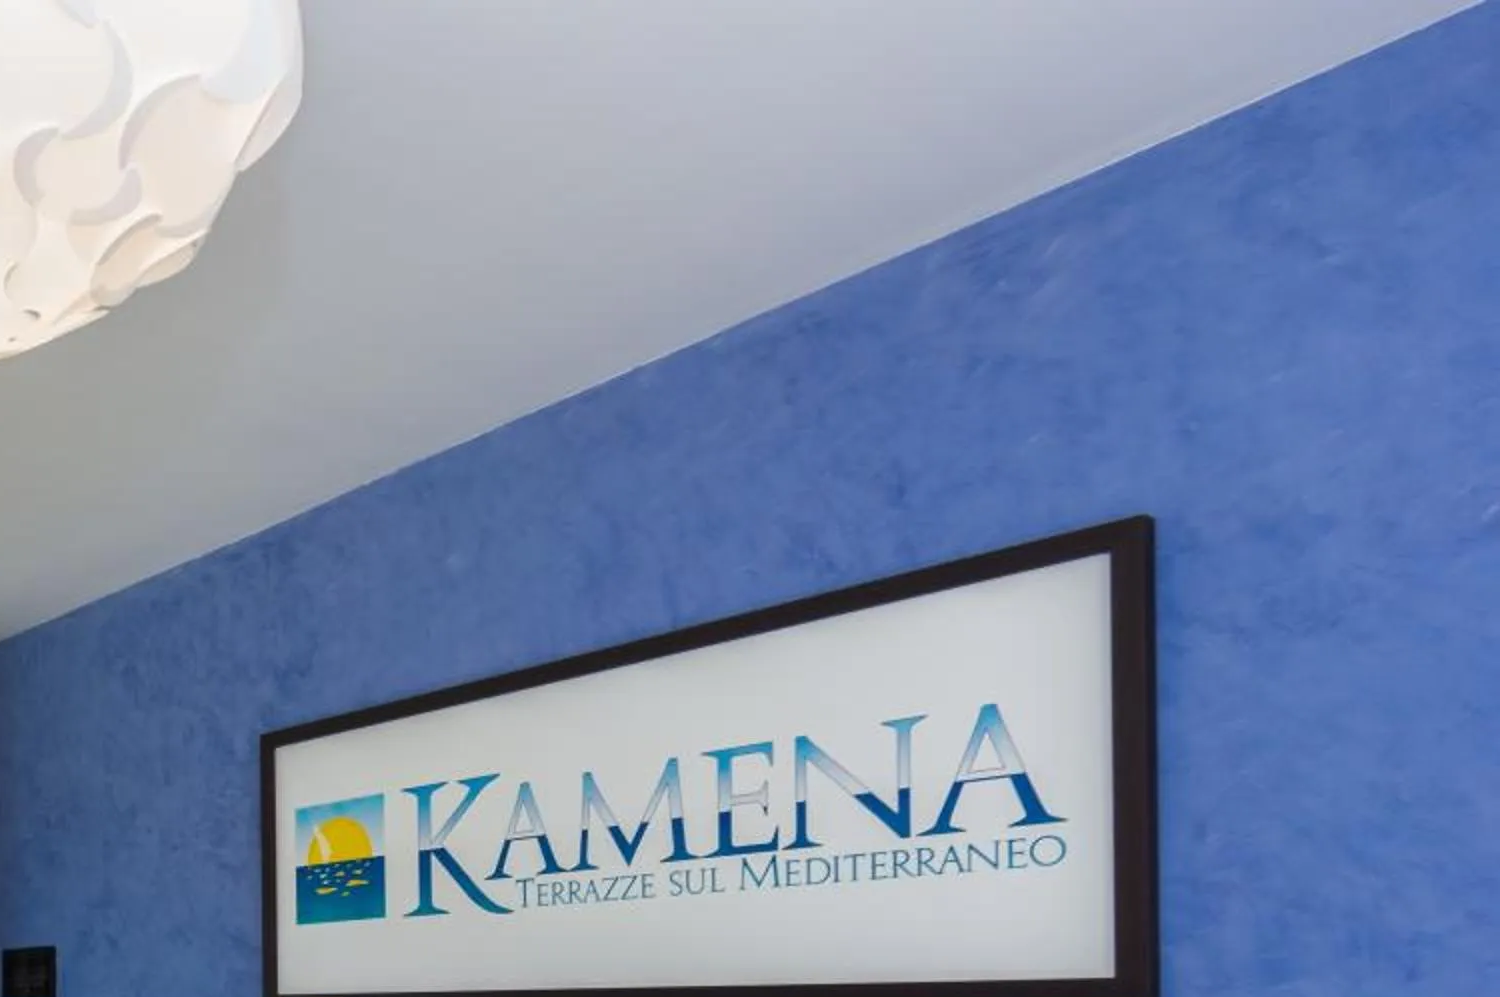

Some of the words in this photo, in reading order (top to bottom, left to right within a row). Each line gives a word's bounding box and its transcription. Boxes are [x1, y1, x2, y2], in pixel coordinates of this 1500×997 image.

[401, 702, 1069, 917] KAMENA
[515, 873, 656, 909] TERRAZZE
[668, 867, 726, 898] SUL
[739, 834, 1067, 891] MEDITERRANEO
